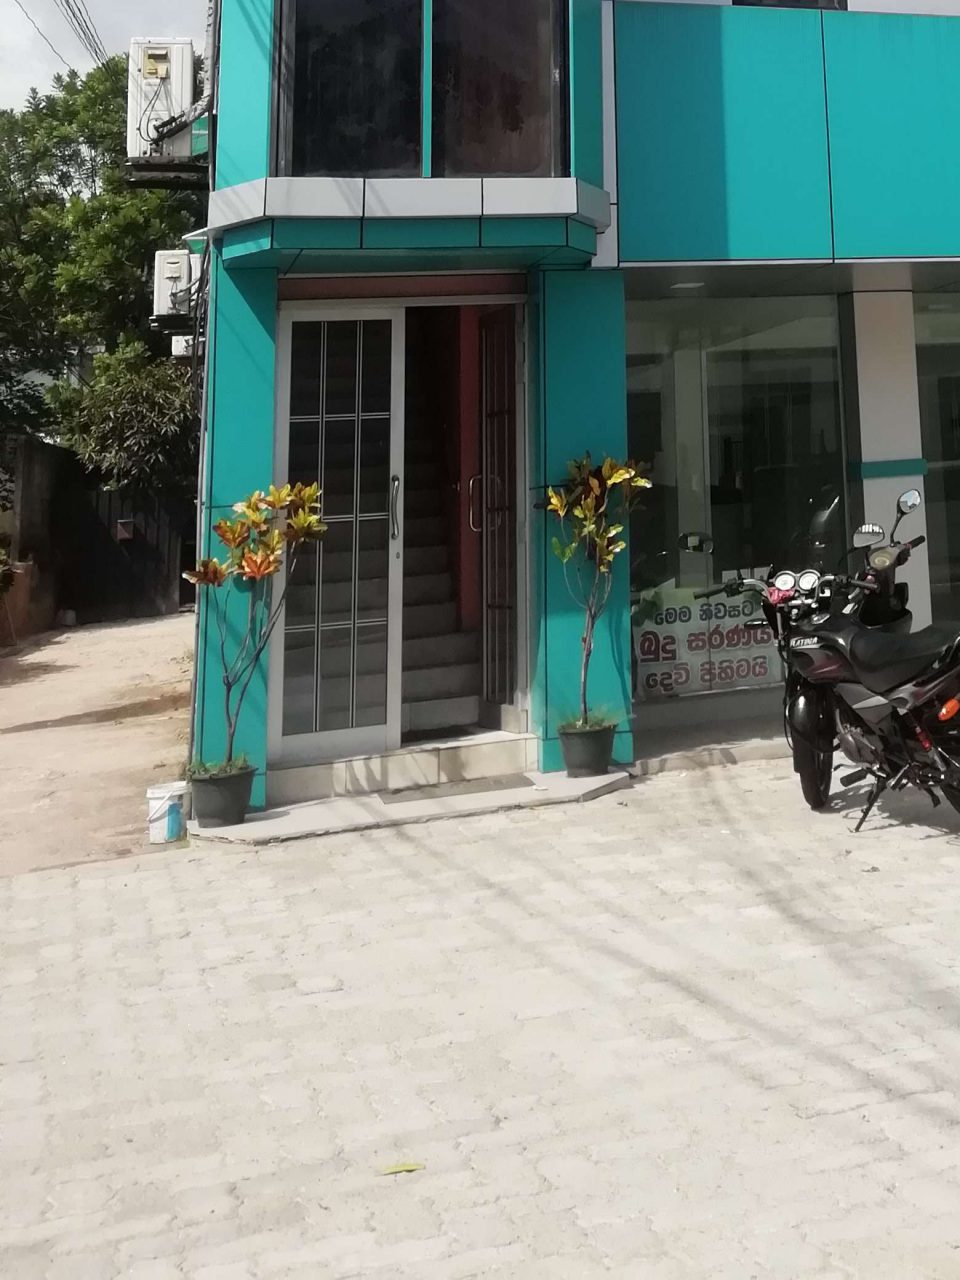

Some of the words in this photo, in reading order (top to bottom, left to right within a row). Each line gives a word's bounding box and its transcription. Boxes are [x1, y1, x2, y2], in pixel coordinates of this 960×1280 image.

[654, 605, 692, 626] මෙම
[639, 629, 678, 663] බුදු
[645, 662, 691, 692] දෙවි
